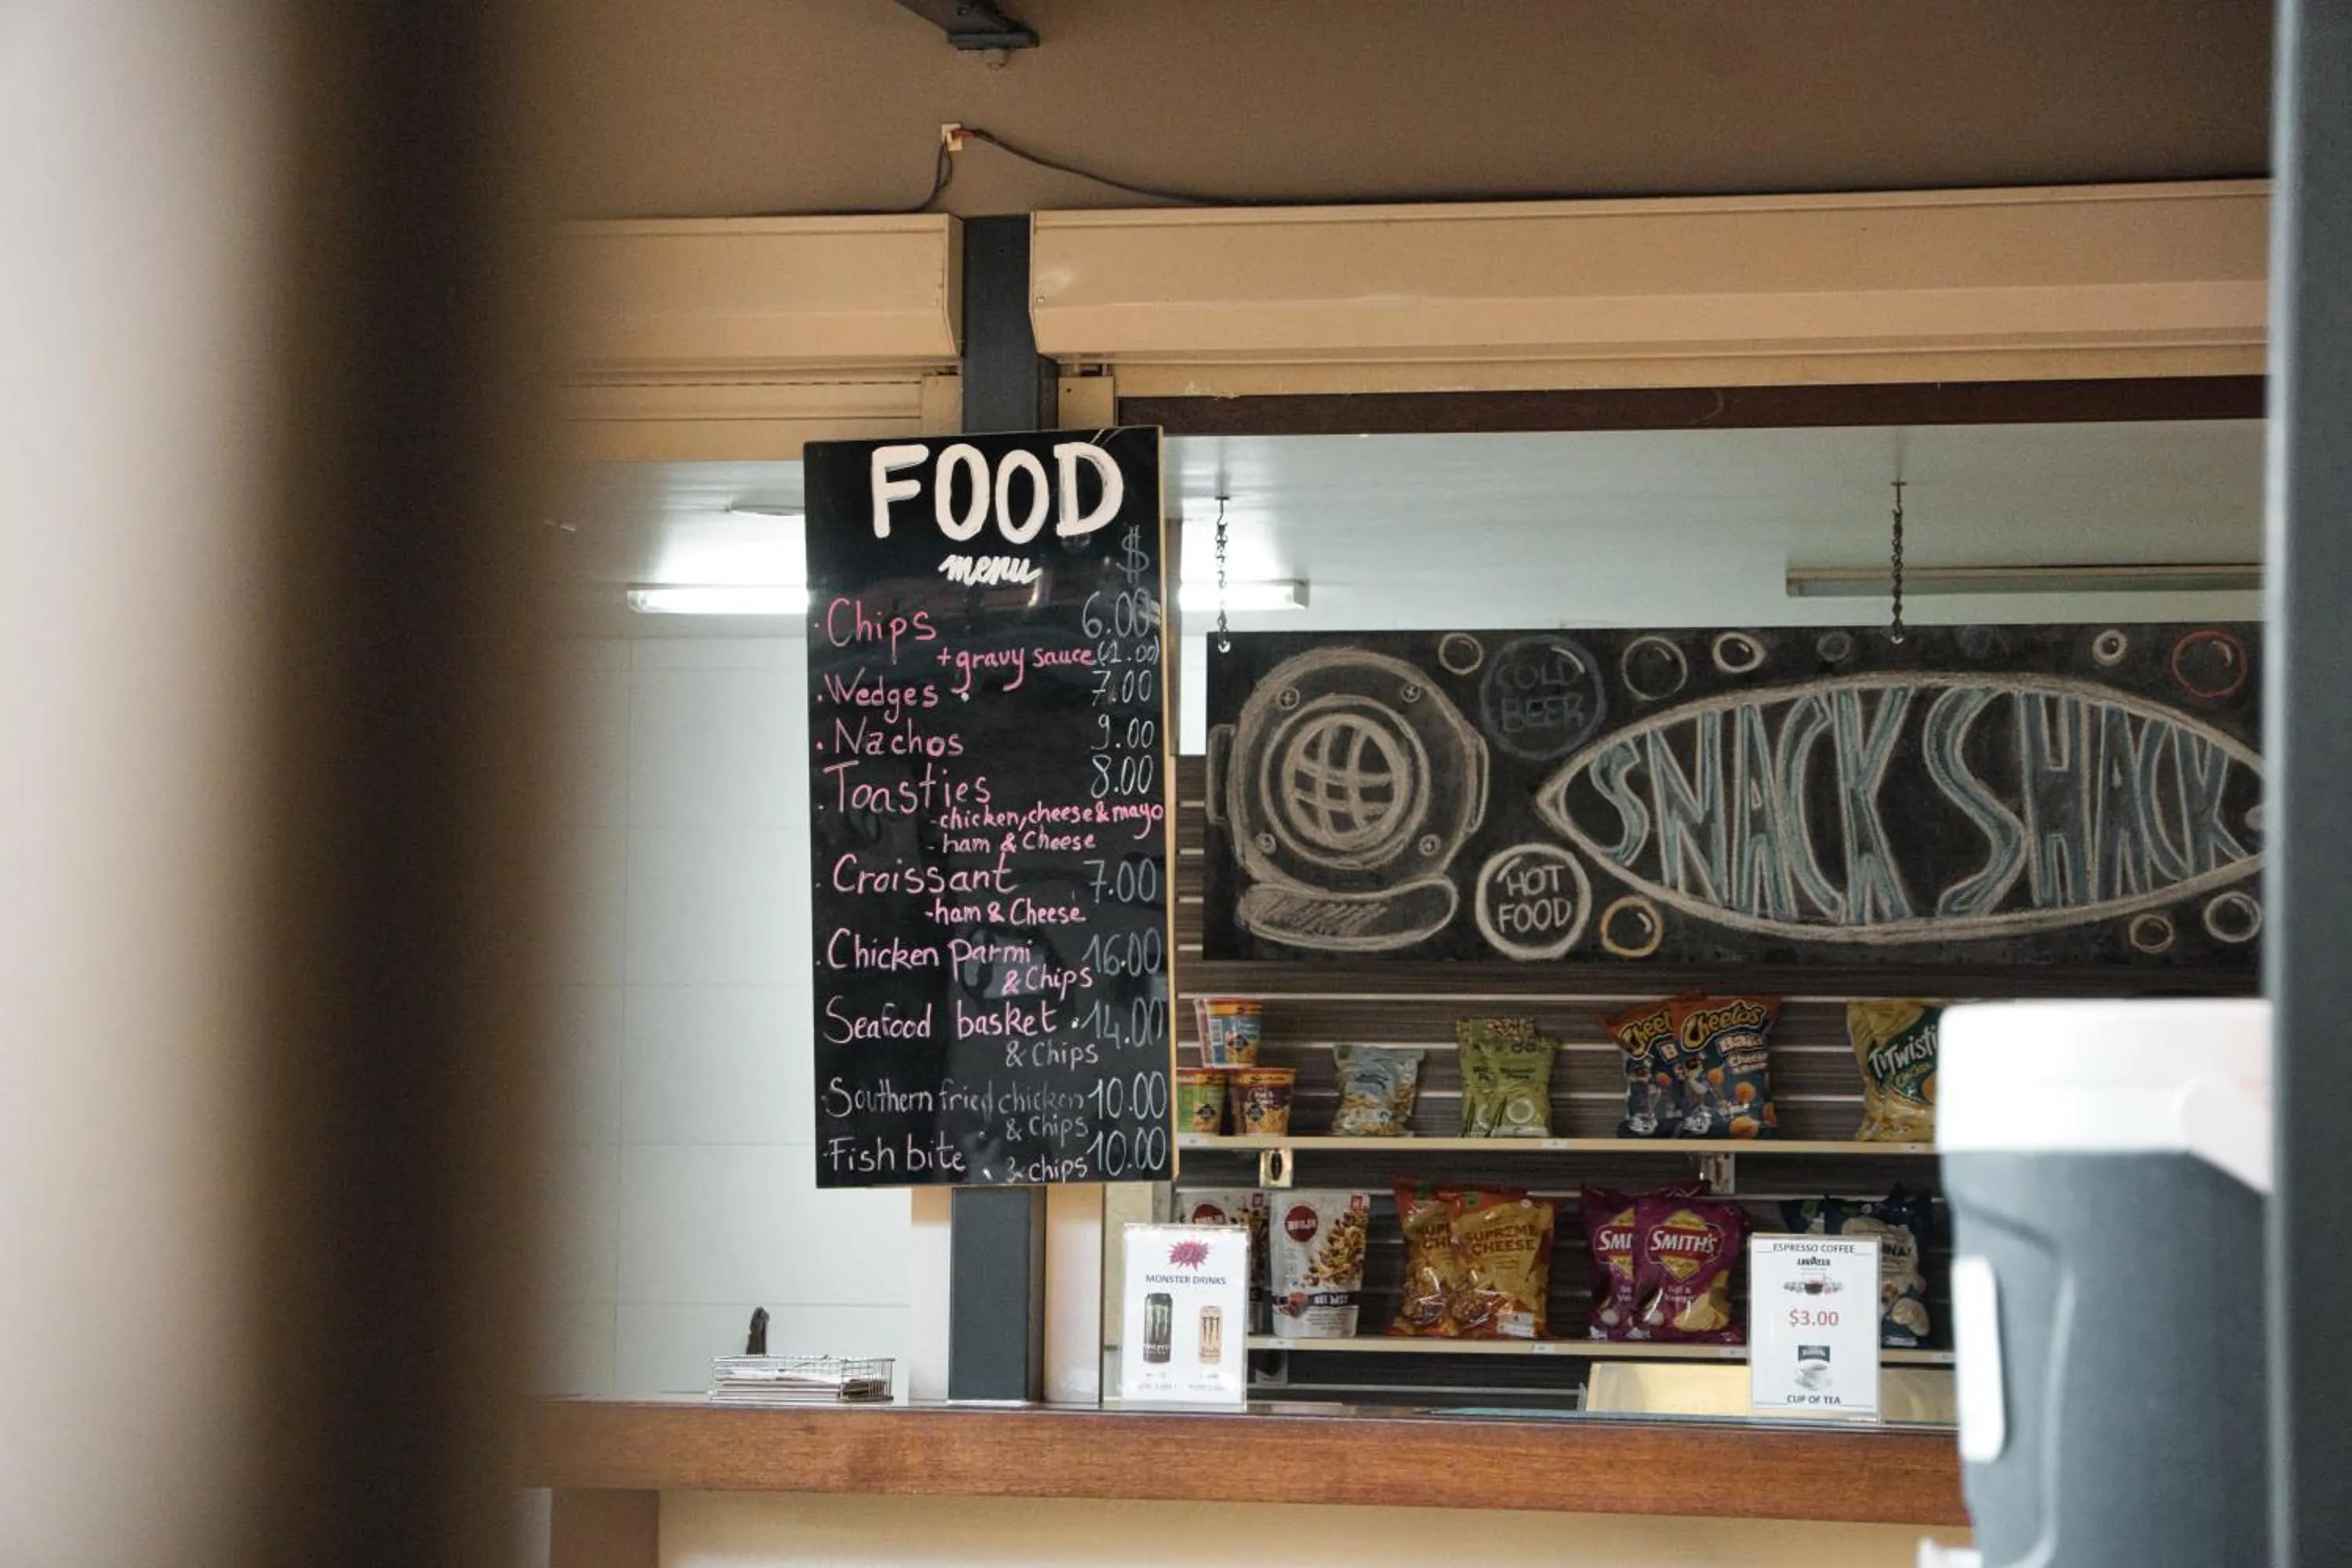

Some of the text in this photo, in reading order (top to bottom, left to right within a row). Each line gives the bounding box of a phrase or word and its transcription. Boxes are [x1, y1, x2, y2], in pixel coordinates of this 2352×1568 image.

[871, 442, 1124, 544] FOOD
[938, 554, 1043, 586] menu
[1116, 525, 1150, 584] $
[827, 588, 1151, 665] Chips 6.00
[1033, 646, 1097, 668] sauce
[1495, 659, 1582, 690] COLD
[824, 666, 1152, 724] Wedges 7.00
[1500, 693, 1584, 733] BEER
[834, 712, 1156, 757] Nachos 9.00
[822, 754, 1154, 814] Toasties 8.00
[1589, 684, 2249, 924] SNACK SHACK
[942, 834, 991, 855] ham
[1000, 834, 1018, 854] &
[832, 852, 1158, 904] Croissant 7.00
[1505, 864, 1566, 897] HOT
[986, 902, 1005, 924] &
[1010, 898, 1087, 927] Cheese
[1498, 898, 1573, 933] FOOD
[826, 927, 941, 972] Chicken
[1081, 926, 1162, 978] 16.00
[1001, 962, 1094, 1001] & Chips
[822, 994, 1164, 1050] Seafood basket 14.00
[1618, 1008, 1673, 1058] Cheet
[1682, 1001, 1765, 1050] Cheetos
[1005, 1038, 1099, 1073] & Chips
[1884, 1025, 1939, 1075] Twisti
[826, 1070, 1167, 1123] Southern fried chicken 10.00
[1005, 1116, 1022, 1142] &
[828, 1135, 895, 1172] Fish
[906, 1131, 967, 1172] bite
[1085, 1126, 1167, 1177] 10.00
[1465, 1224, 1537, 1243] SUPREME
[1472, 1239, 1536, 1256] CHEESE
[1773, 1242, 1857, 1254] ESPRESSO COFFEE
[1145, 1274, 1227, 1285] MONSTER DRINKS
[1788, 1308, 1839, 1327] $3.00
[1786, 1394, 1842, 1406] CUP OF TEA
